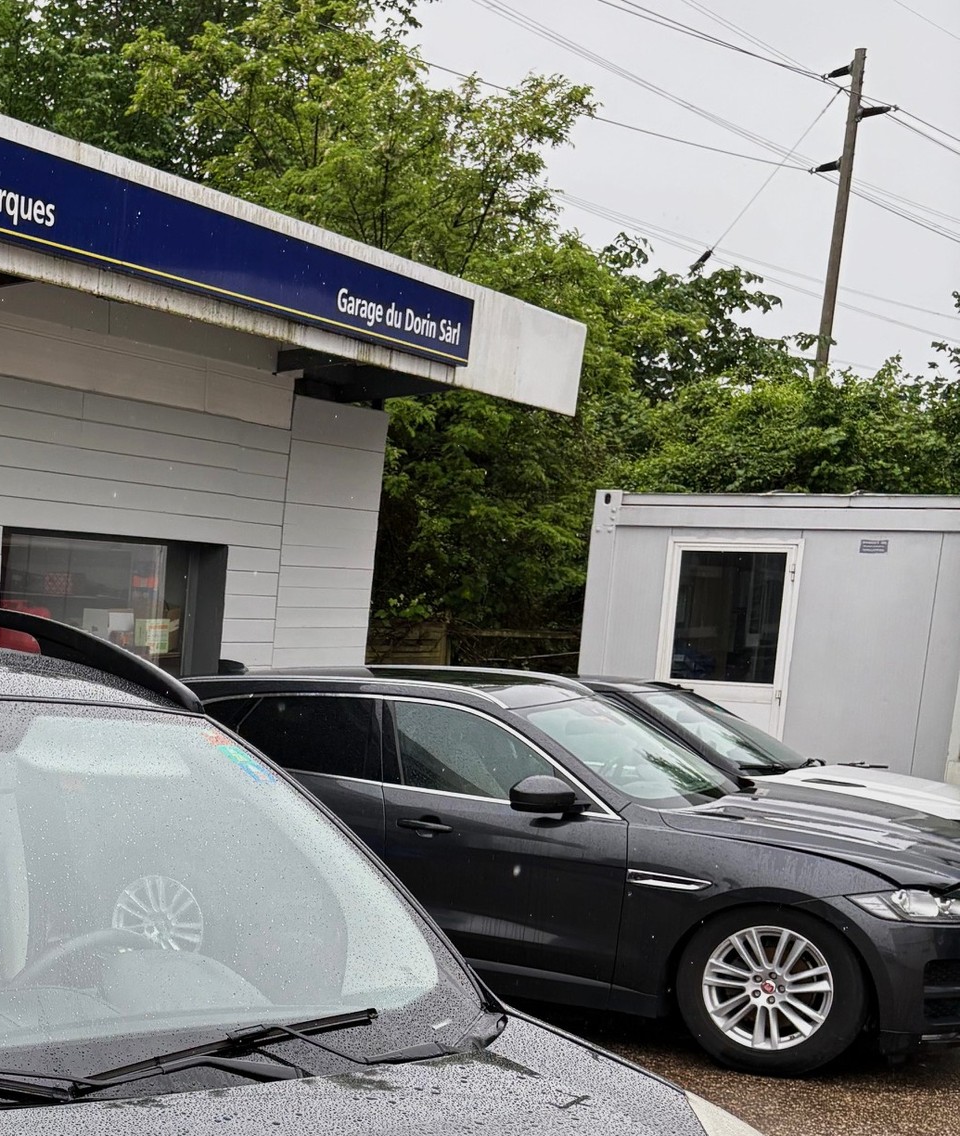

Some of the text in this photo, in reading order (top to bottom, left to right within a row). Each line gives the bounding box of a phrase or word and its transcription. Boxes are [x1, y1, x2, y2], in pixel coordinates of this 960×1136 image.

[337, 288, 461, 346] Garage du Dorin Sàrl
